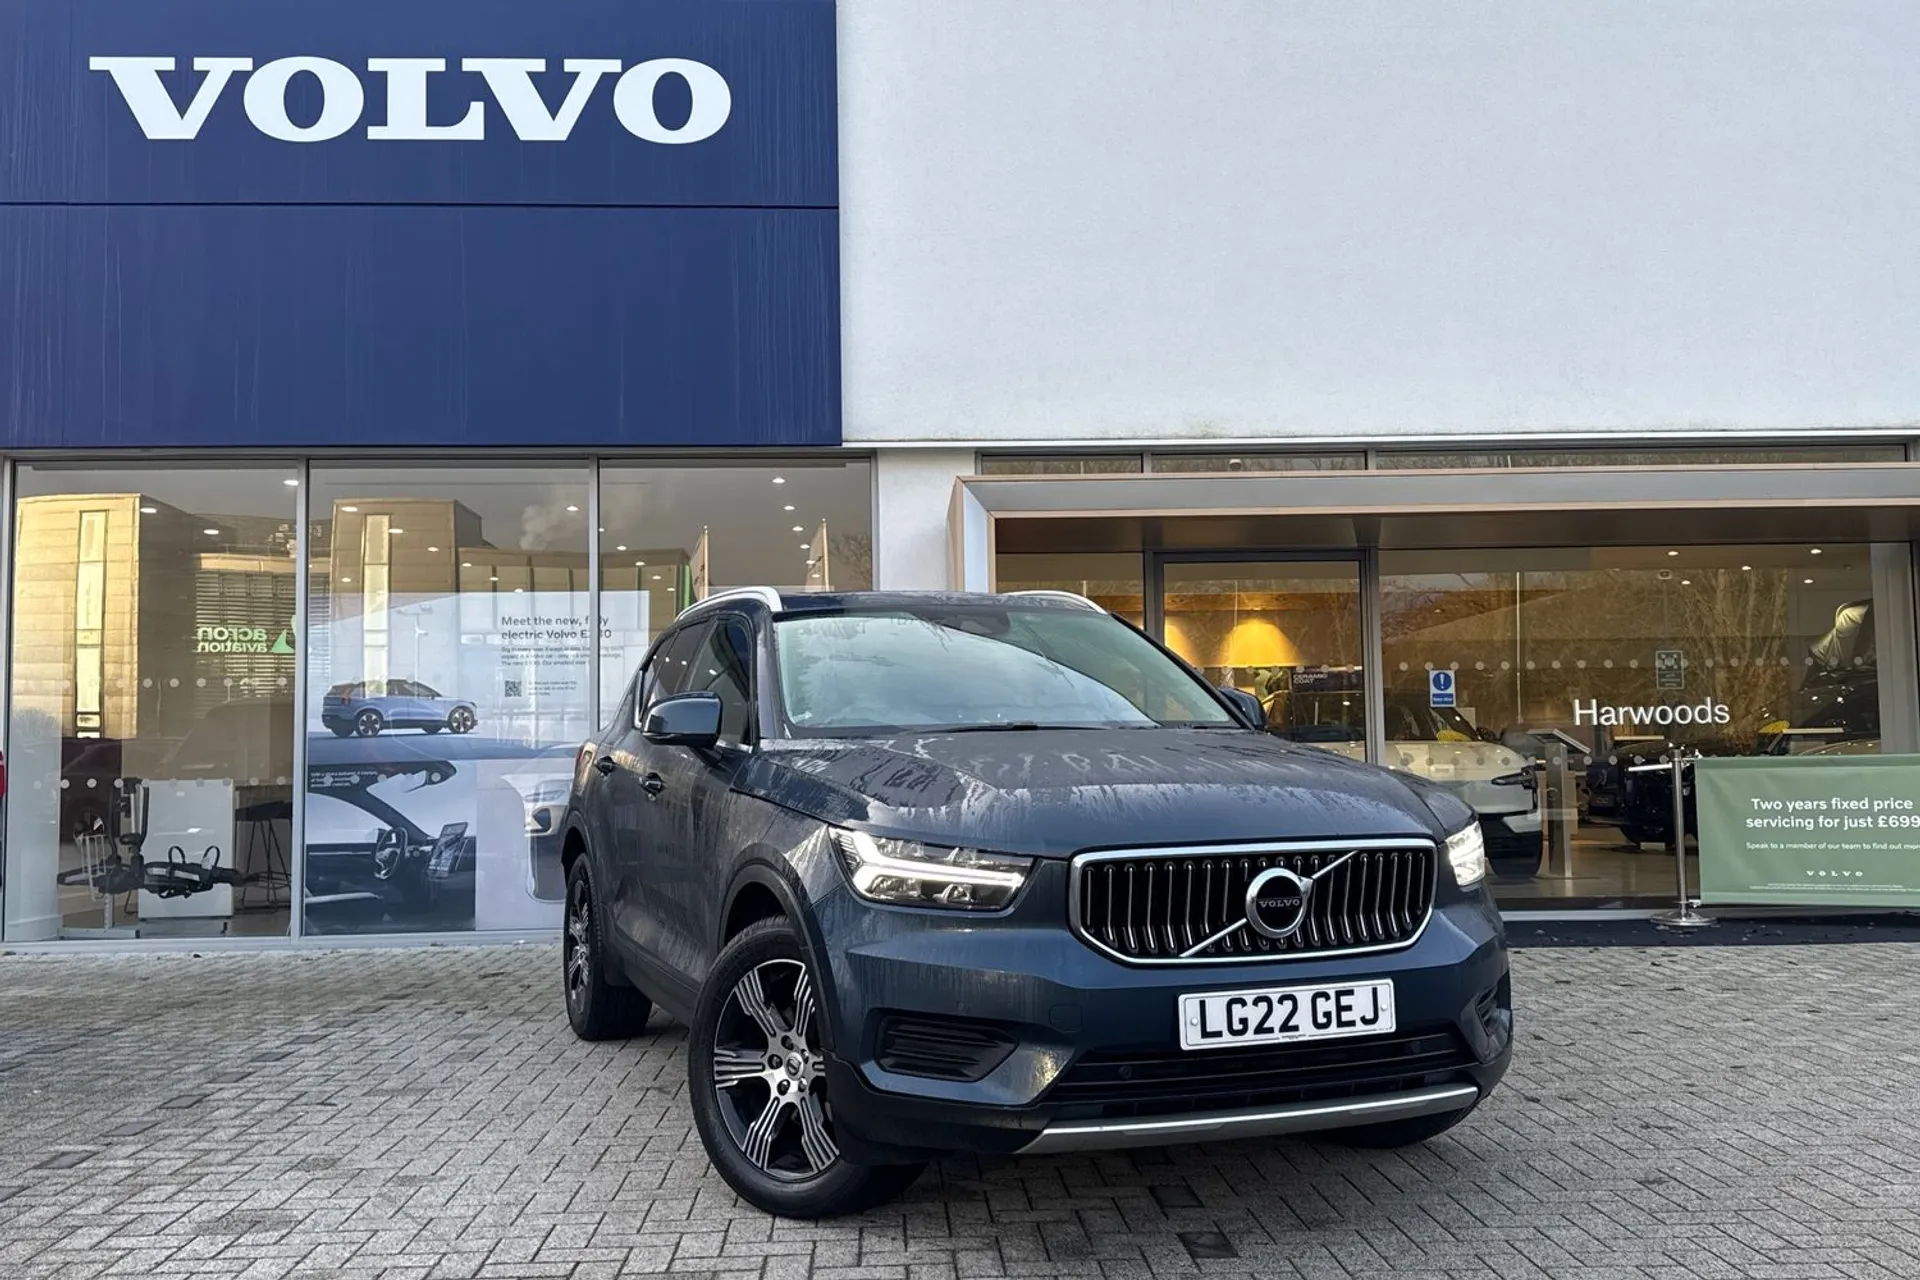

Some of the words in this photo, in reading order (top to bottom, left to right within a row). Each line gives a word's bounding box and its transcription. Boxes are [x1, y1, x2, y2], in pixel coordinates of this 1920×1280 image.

[89, 56, 732, 144] VOLVO
[501, 616, 531, 626] Meet
[534, 615, 553, 626] the
[555, 617, 582, 627] new,
[501, 629, 544, 640] electric
[546, 629, 578, 639] Volvo
[1574, 697, 1731, 727] Harwoods
[1751, 798, 1783, 811] Two
[1786, 799, 1828, 813] years
[1831, 797, 1869, 810] fixed
[1873, 797, 1914, 812] price
[1746, 815, 1815, 831] servicing
[1818, 815, 1840, 828] for
[1843, 815, 1874, 831] just
[1877, 815, 1920, 828] £699
[1746, 841, 1769, 851] Speak
[1769, 841, 1779, 850] to
[1786, 841, 1817, 850] member
[1818, 841, 1827, 850] of
[1841, 842, 1861, 850] team
[1862, 842, 1872, 850] to
[1872, 841, 1888, 850] find
[1888, 842, 1902, 850] out
[1258, 898, 1300, 908] VOLVO
[1199, 993, 1300, 1040] LG22
[1311, 986, 1379, 1030] GEJ
